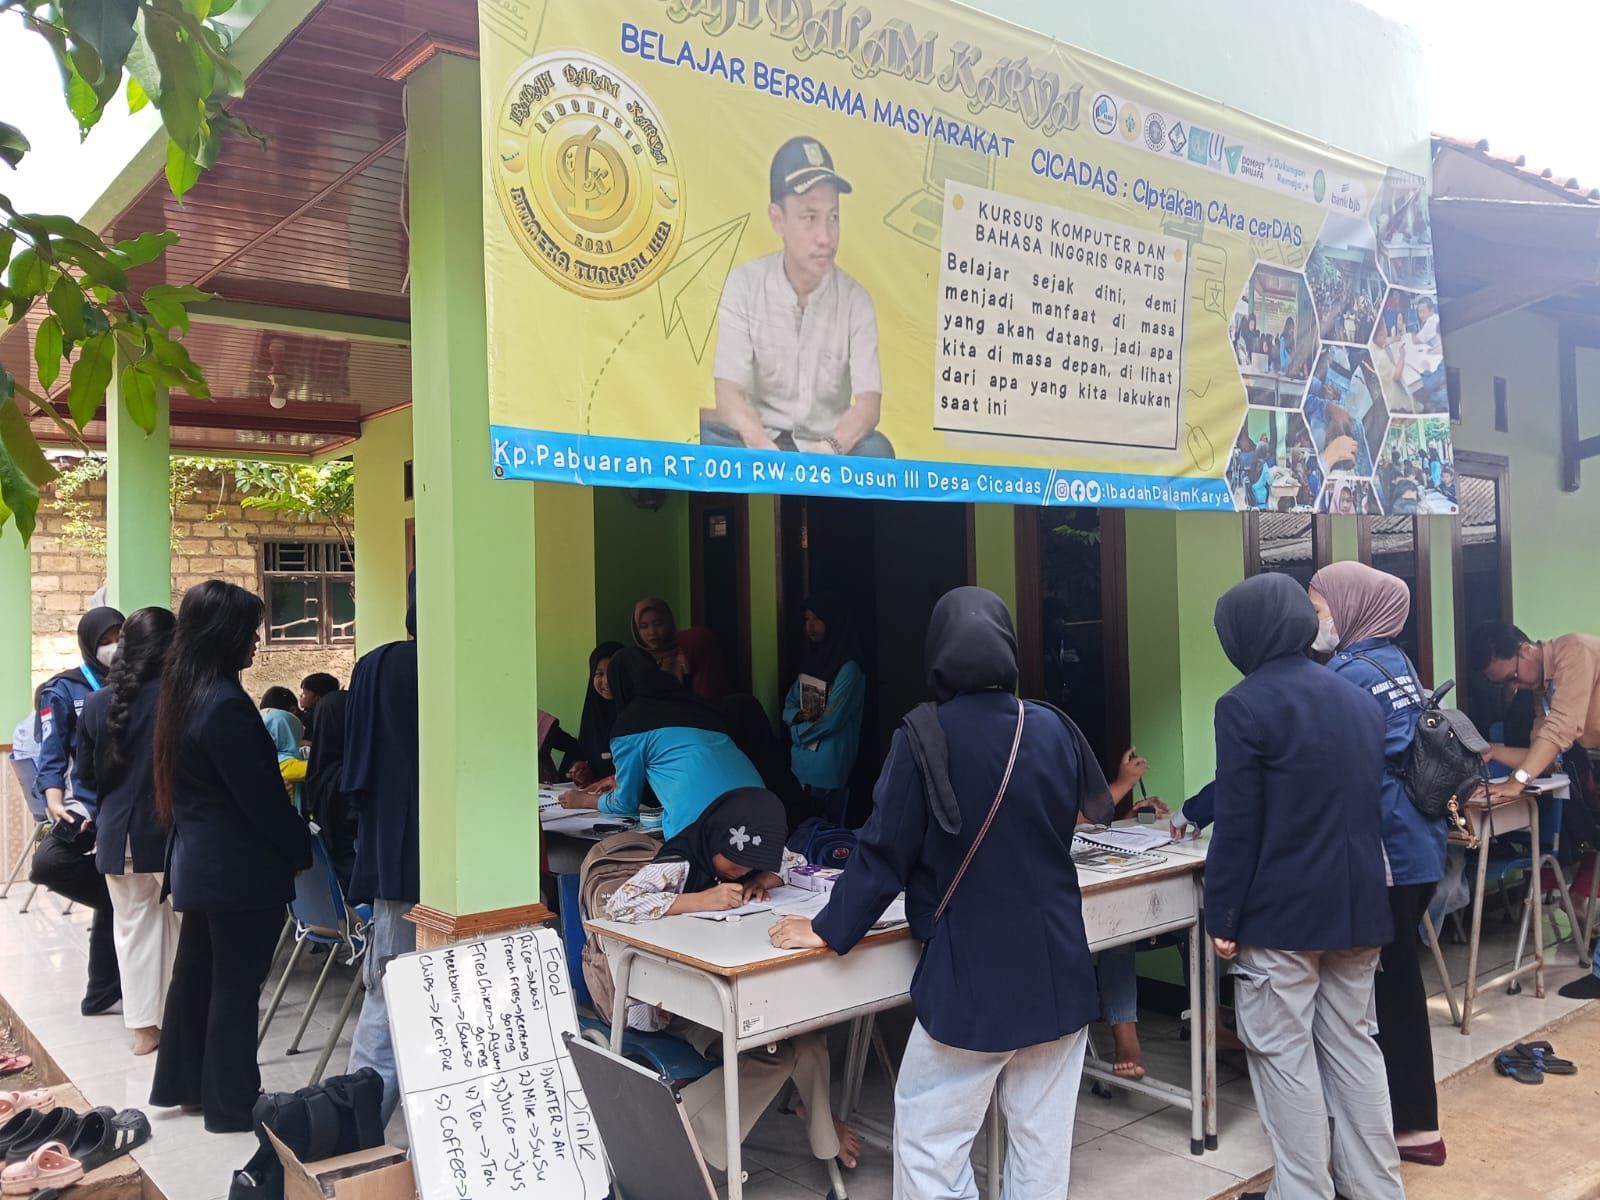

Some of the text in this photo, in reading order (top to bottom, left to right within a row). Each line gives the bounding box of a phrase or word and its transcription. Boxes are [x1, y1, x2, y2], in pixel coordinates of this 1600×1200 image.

[937, 41, 1084, 137] KARYA
[534, 99, 644, 156] INDONESIA
[621, 22, 746, 85] BELAJAR
[753, 61, 867, 120] BERSAMA
[873, 98, 1015, 159] MASYARAKAT
[1031, 149, 1118, 197] CICADAS
[1132, 178, 1203, 221] CIptakan
[1207, 200, 1245, 232] CAra
[1249, 217, 1303, 247] cerDAS
[1241, 156, 1266, 171] DOMPET
[1241, 166, 1265, 180] DHUAFA
[1331, 191, 1361, 213] bank bjb
[574, 233, 614, 254] 2021
[976, 224, 1165, 281] BAHASA INGGRIS GRATIS
[978, 201, 1166, 261] KURSUS KOMPUTER DAN
[947, 252, 1010, 281] Belajar
[1032, 273, 1074, 295] sejak
[1145, 295, 1177, 314] demi
[945, 285, 1175, 337] menjadi manfaat di masa
[944, 313, 1173, 361] yang akan datang, jadi apa
[942, 338, 1173, 385] kita di masa depan, di lihat
[940, 394, 1008, 416] saat ini
[941, 366, 1171, 409] dari apa yang kita lakukan
[493, 438, 653, 475] Kp.Pabuaran
[664, 454, 743, 480] RT.001
[752, 461, 831, 485] RW.026
[841, 466, 897, 489] Dusun
[903, 470, 919, 489] III
[928, 472, 970, 492] Desa
[977, 474, 1042, 495] Cicadas
[466, 1100, 487, 1132] Tea
